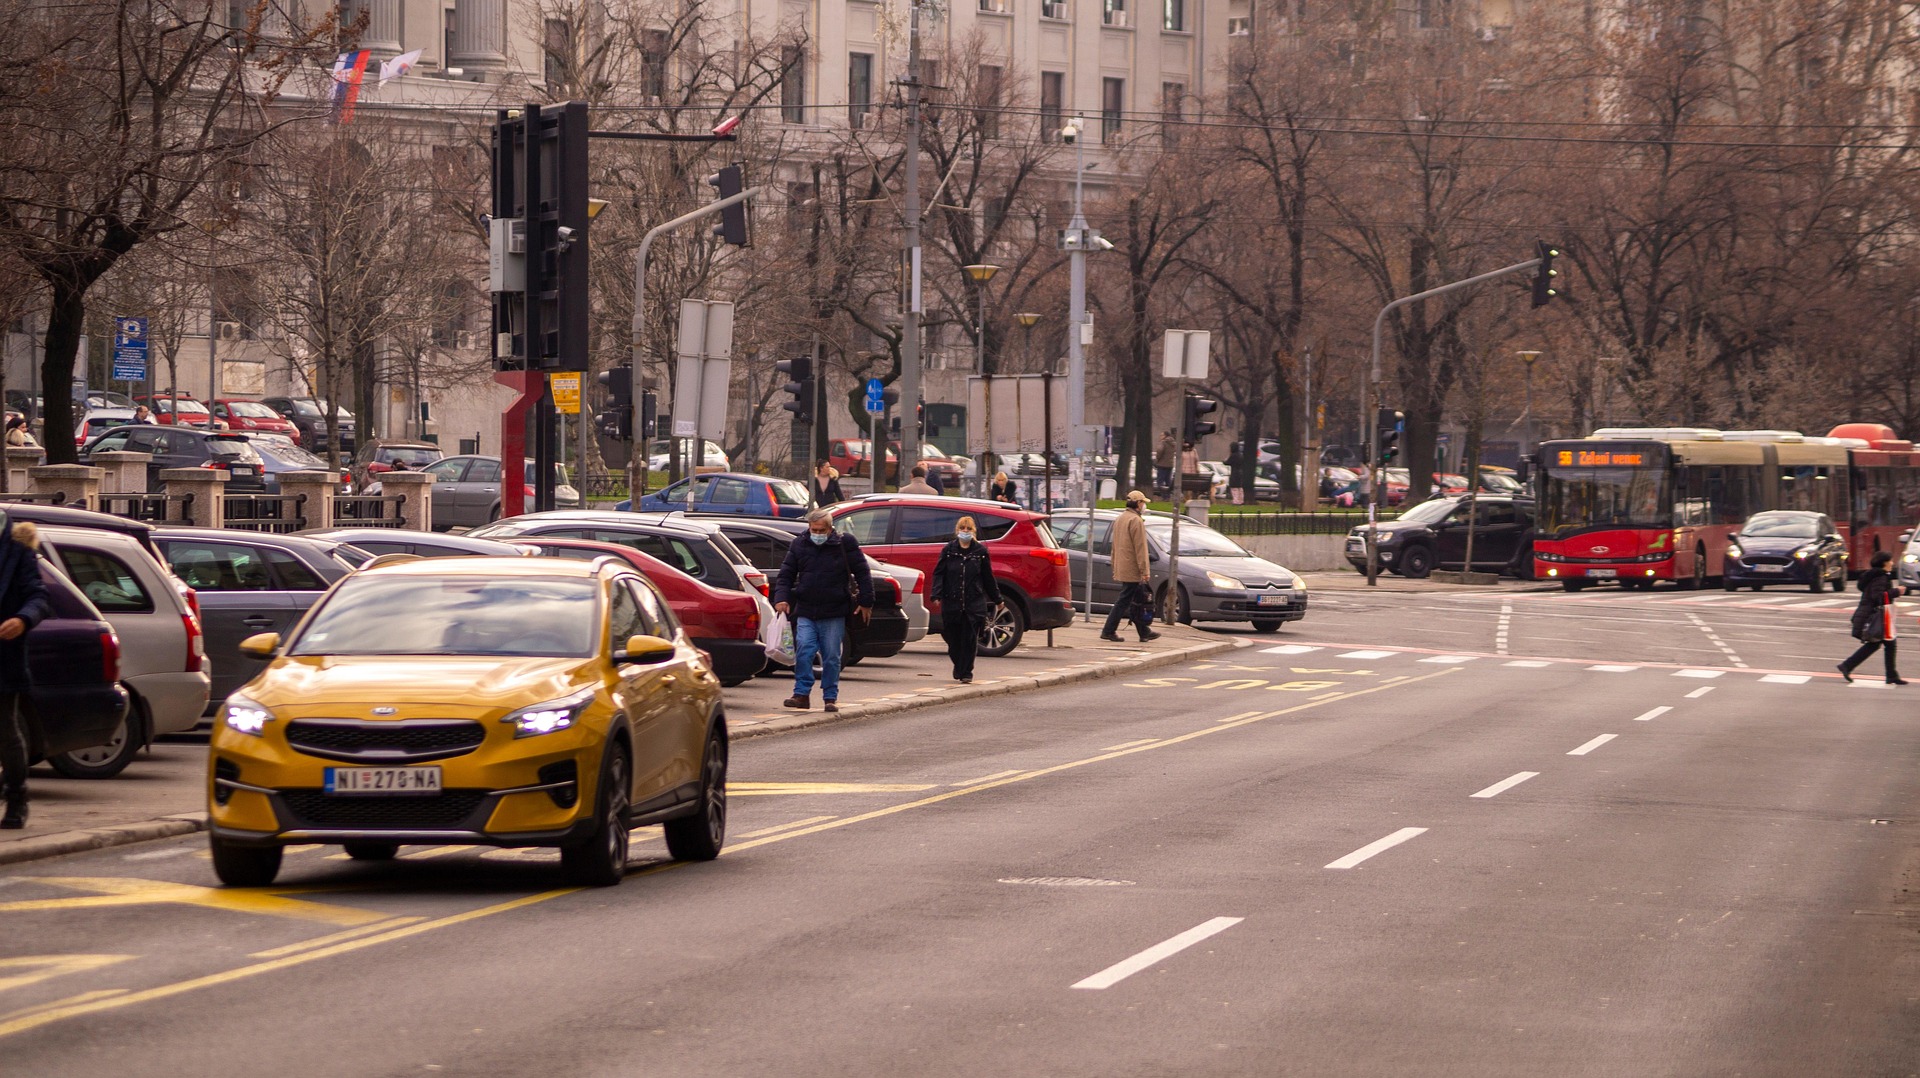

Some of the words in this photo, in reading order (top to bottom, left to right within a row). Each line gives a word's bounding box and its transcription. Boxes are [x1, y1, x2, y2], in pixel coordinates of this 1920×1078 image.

[122, 320, 141, 344] P
[1558, 451, 1573, 465] 56
[1579, 451, 1610, 466] Zeleni
[1189, 664, 1380, 676] TAXI
[1123, 677, 1344, 691] BUS
[338, 770, 357, 789] NI
